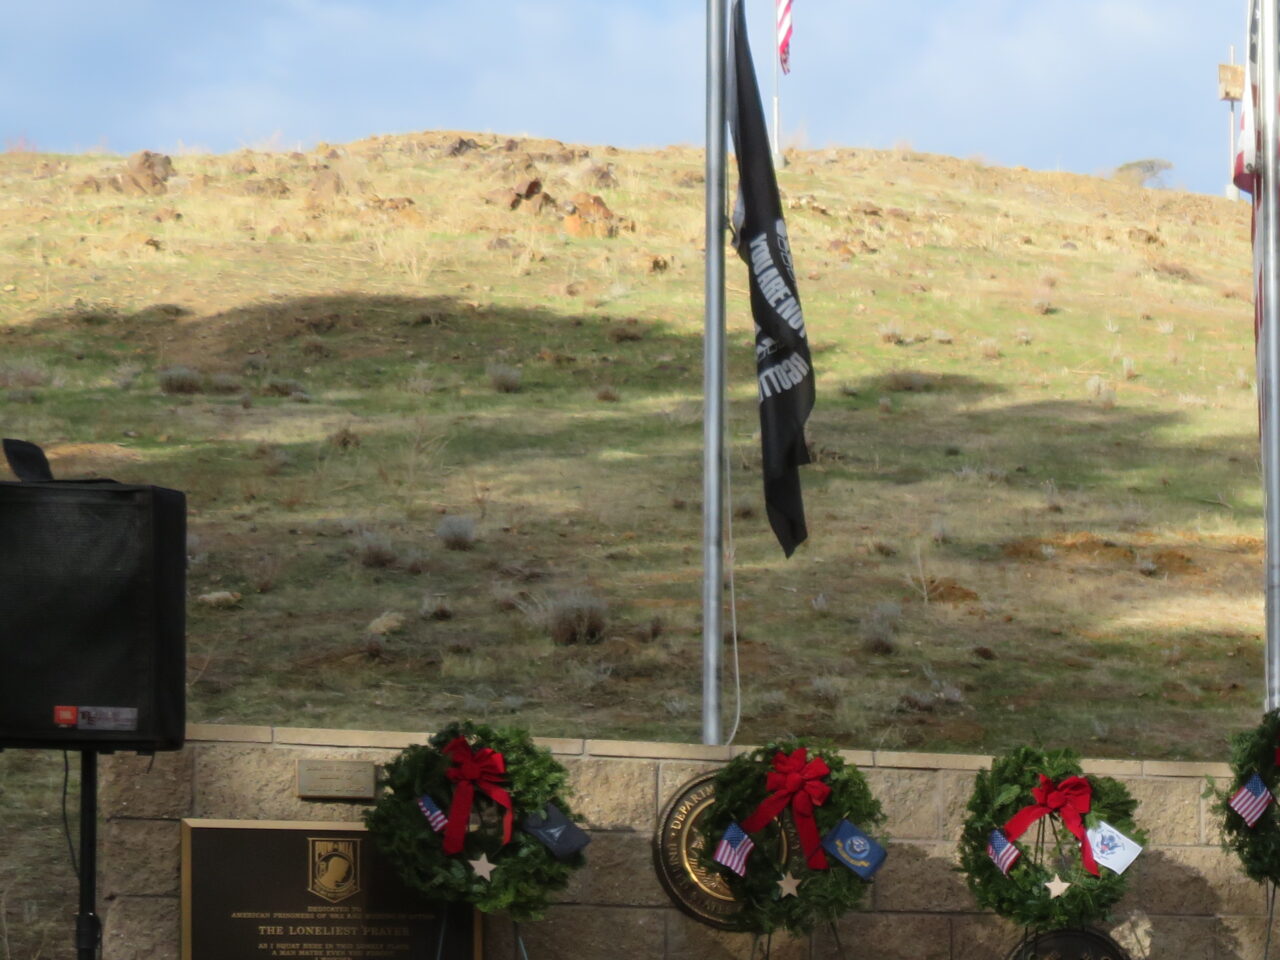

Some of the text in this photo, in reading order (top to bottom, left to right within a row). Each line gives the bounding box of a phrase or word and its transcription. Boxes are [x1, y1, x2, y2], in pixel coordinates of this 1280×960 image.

[750, 233, 774, 276] YOU
[757, 267, 792, 308] ARE
[670, 784, 717, 830] DEPARTM
[259, 926, 410, 936] THE LONELIEST PRAYER
